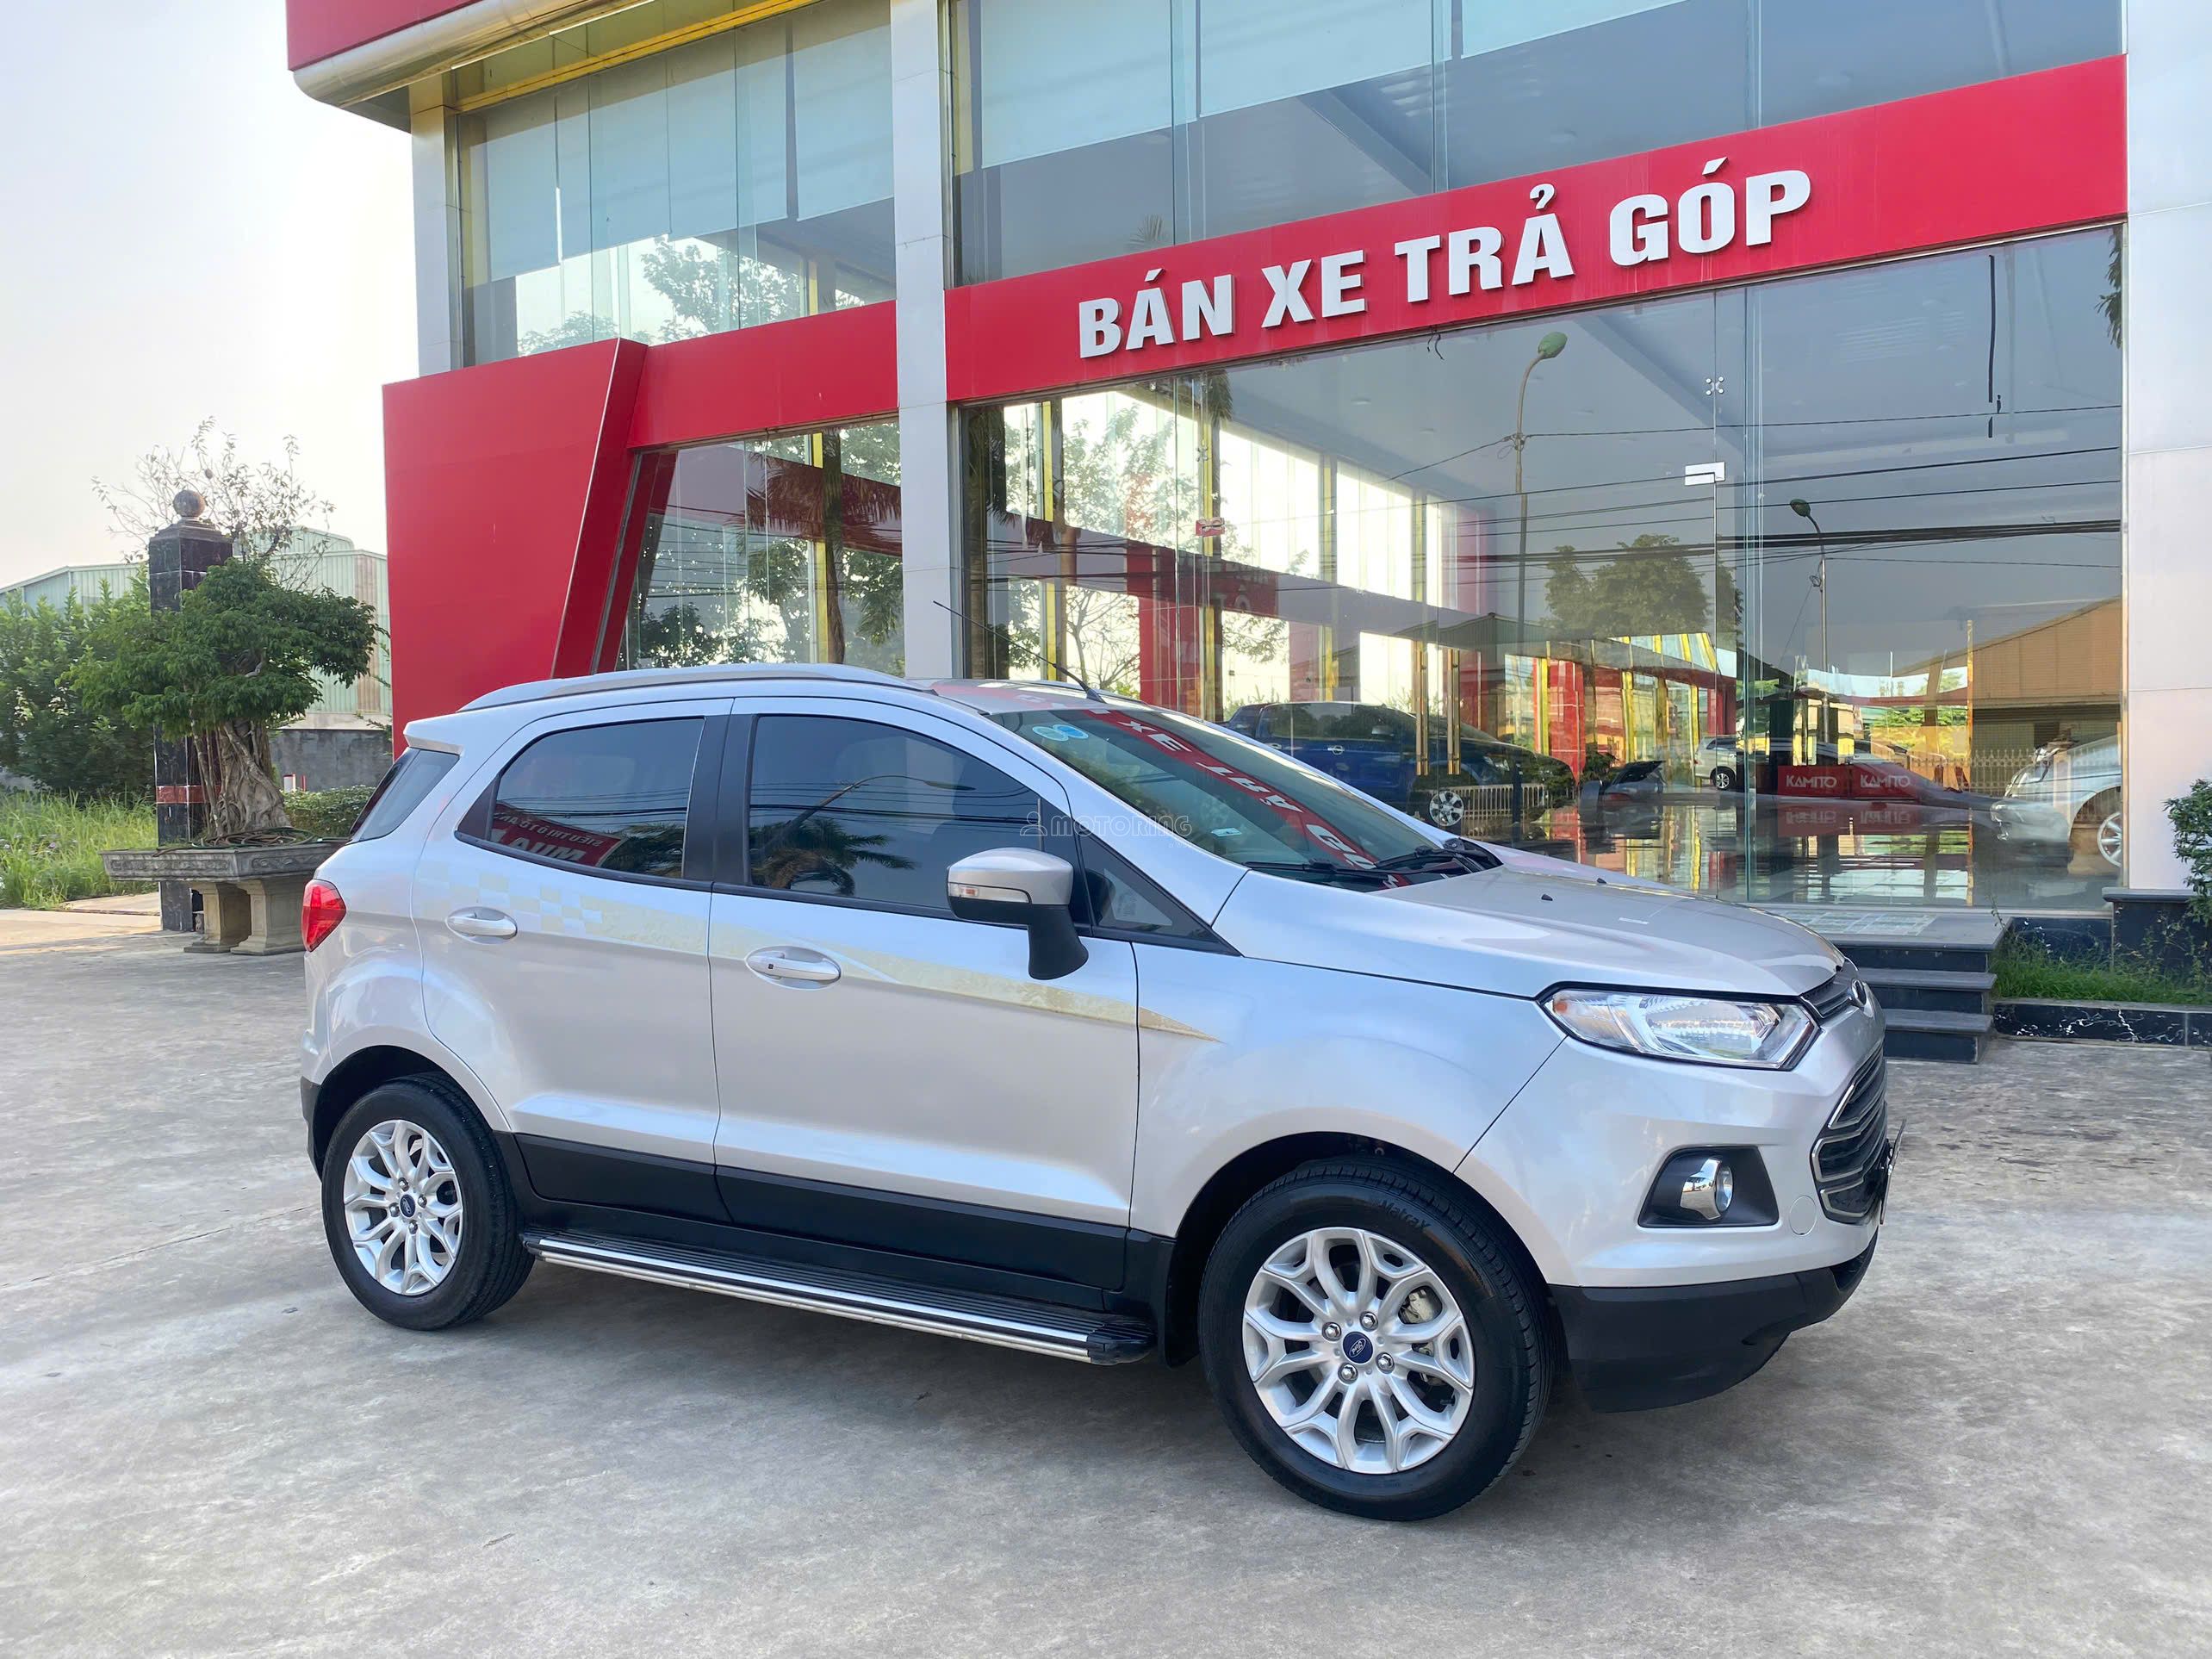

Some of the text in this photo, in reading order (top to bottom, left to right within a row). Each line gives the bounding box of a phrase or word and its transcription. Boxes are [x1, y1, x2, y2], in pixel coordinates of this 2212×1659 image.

[1078, 156, 1812, 358] BÁN XE TRẢ GÓP
[1786, 774, 1837, 788] KAMITO
[1861, 774, 1911, 788] KAMITO
